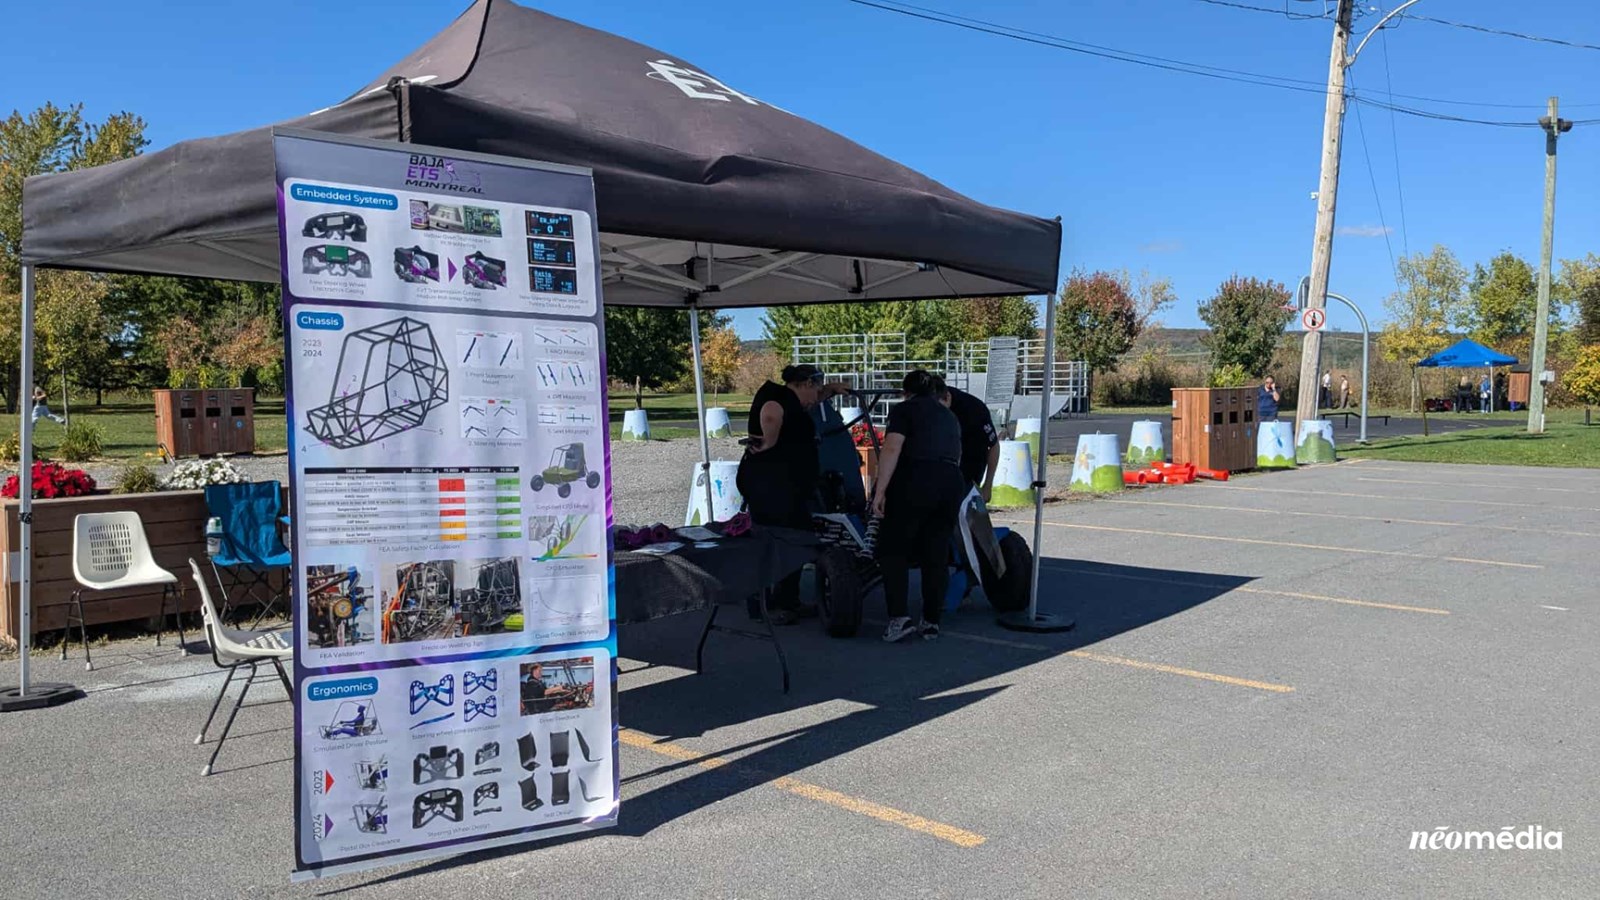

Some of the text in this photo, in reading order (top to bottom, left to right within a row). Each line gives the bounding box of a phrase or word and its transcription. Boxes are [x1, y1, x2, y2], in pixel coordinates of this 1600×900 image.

[409, 155, 445, 168] BAJA
[407, 166, 439, 180] ETS
[405, 179, 485, 194] MONTREAL
[296, 188, 393, 206] Embedded Systems
[301, 316, 339, 326] Chassis
[302, 339, 322, 347] 2023
[352, 374, 357, 382] 2
[313, 682, 374, 697] Ergonomics
[313, 769, 323, 795] 2023
[312, 813, 323, 840] 2024
